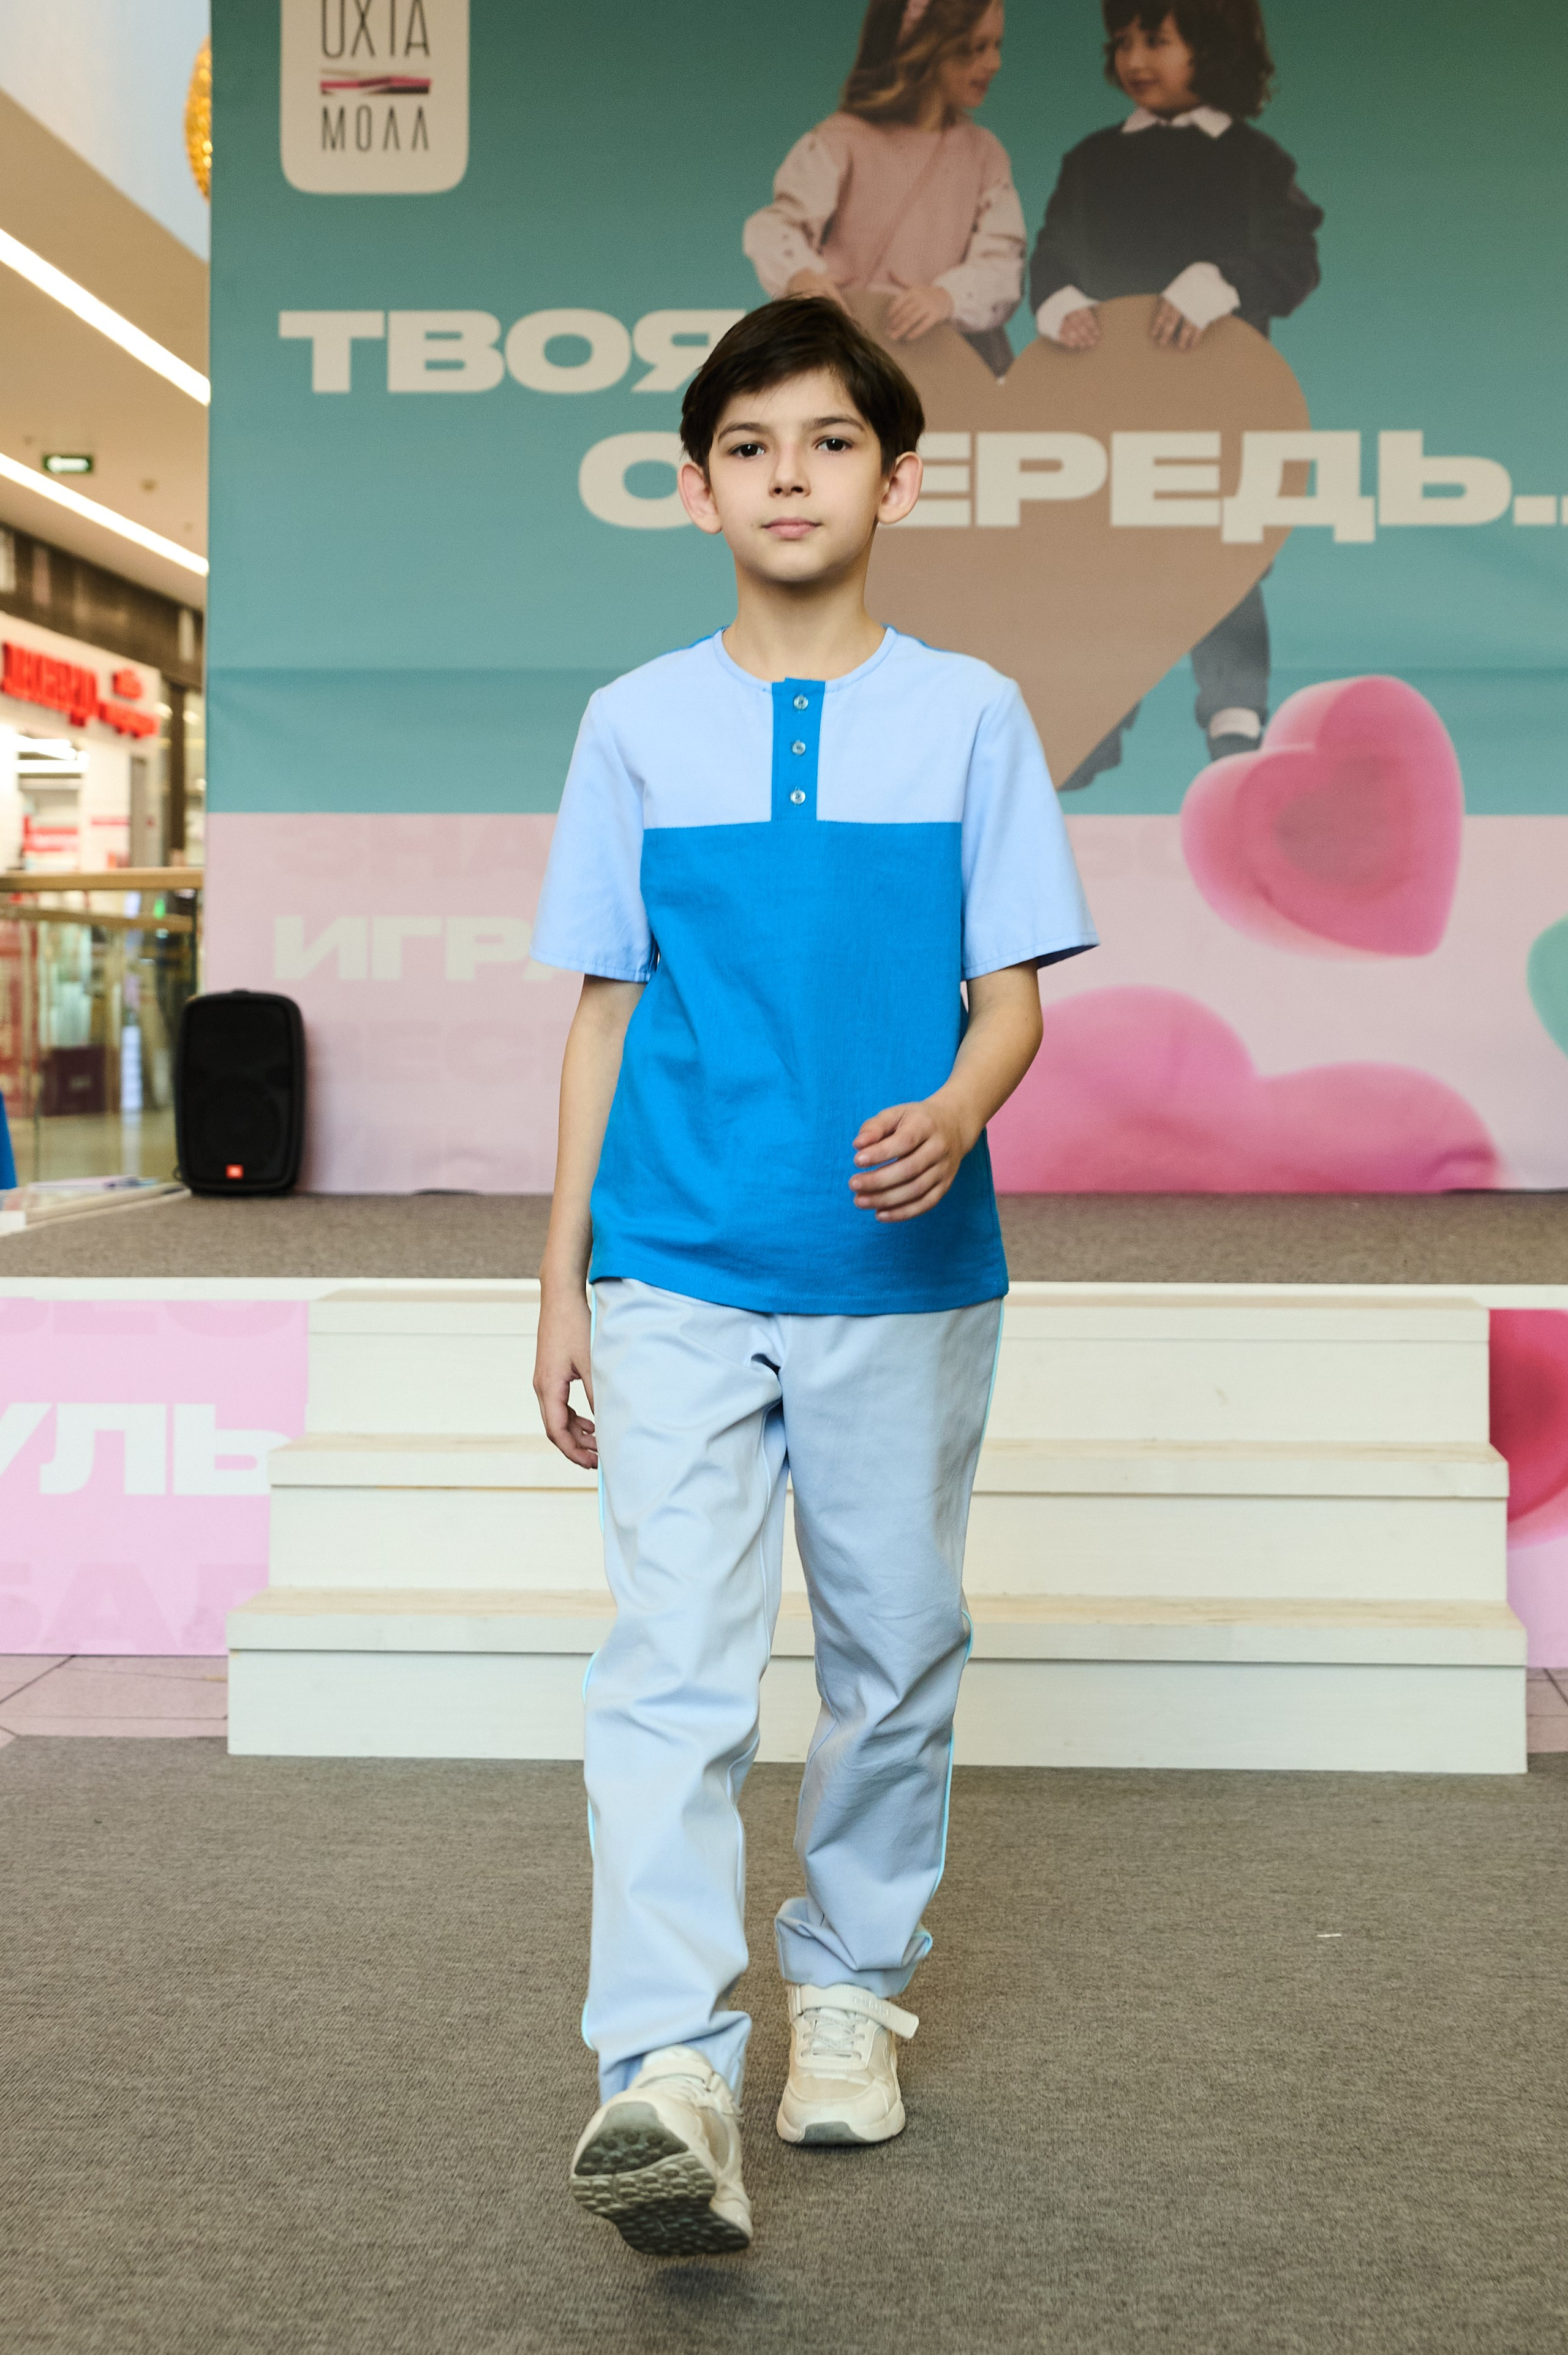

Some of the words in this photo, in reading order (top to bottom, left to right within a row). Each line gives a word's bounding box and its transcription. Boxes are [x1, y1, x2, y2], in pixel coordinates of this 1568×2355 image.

[322, 105, 429, 151] МОЛЛ
[279, 308, 746, 394] ТВОЯ
[274, 917, 559, 981] ИГР
